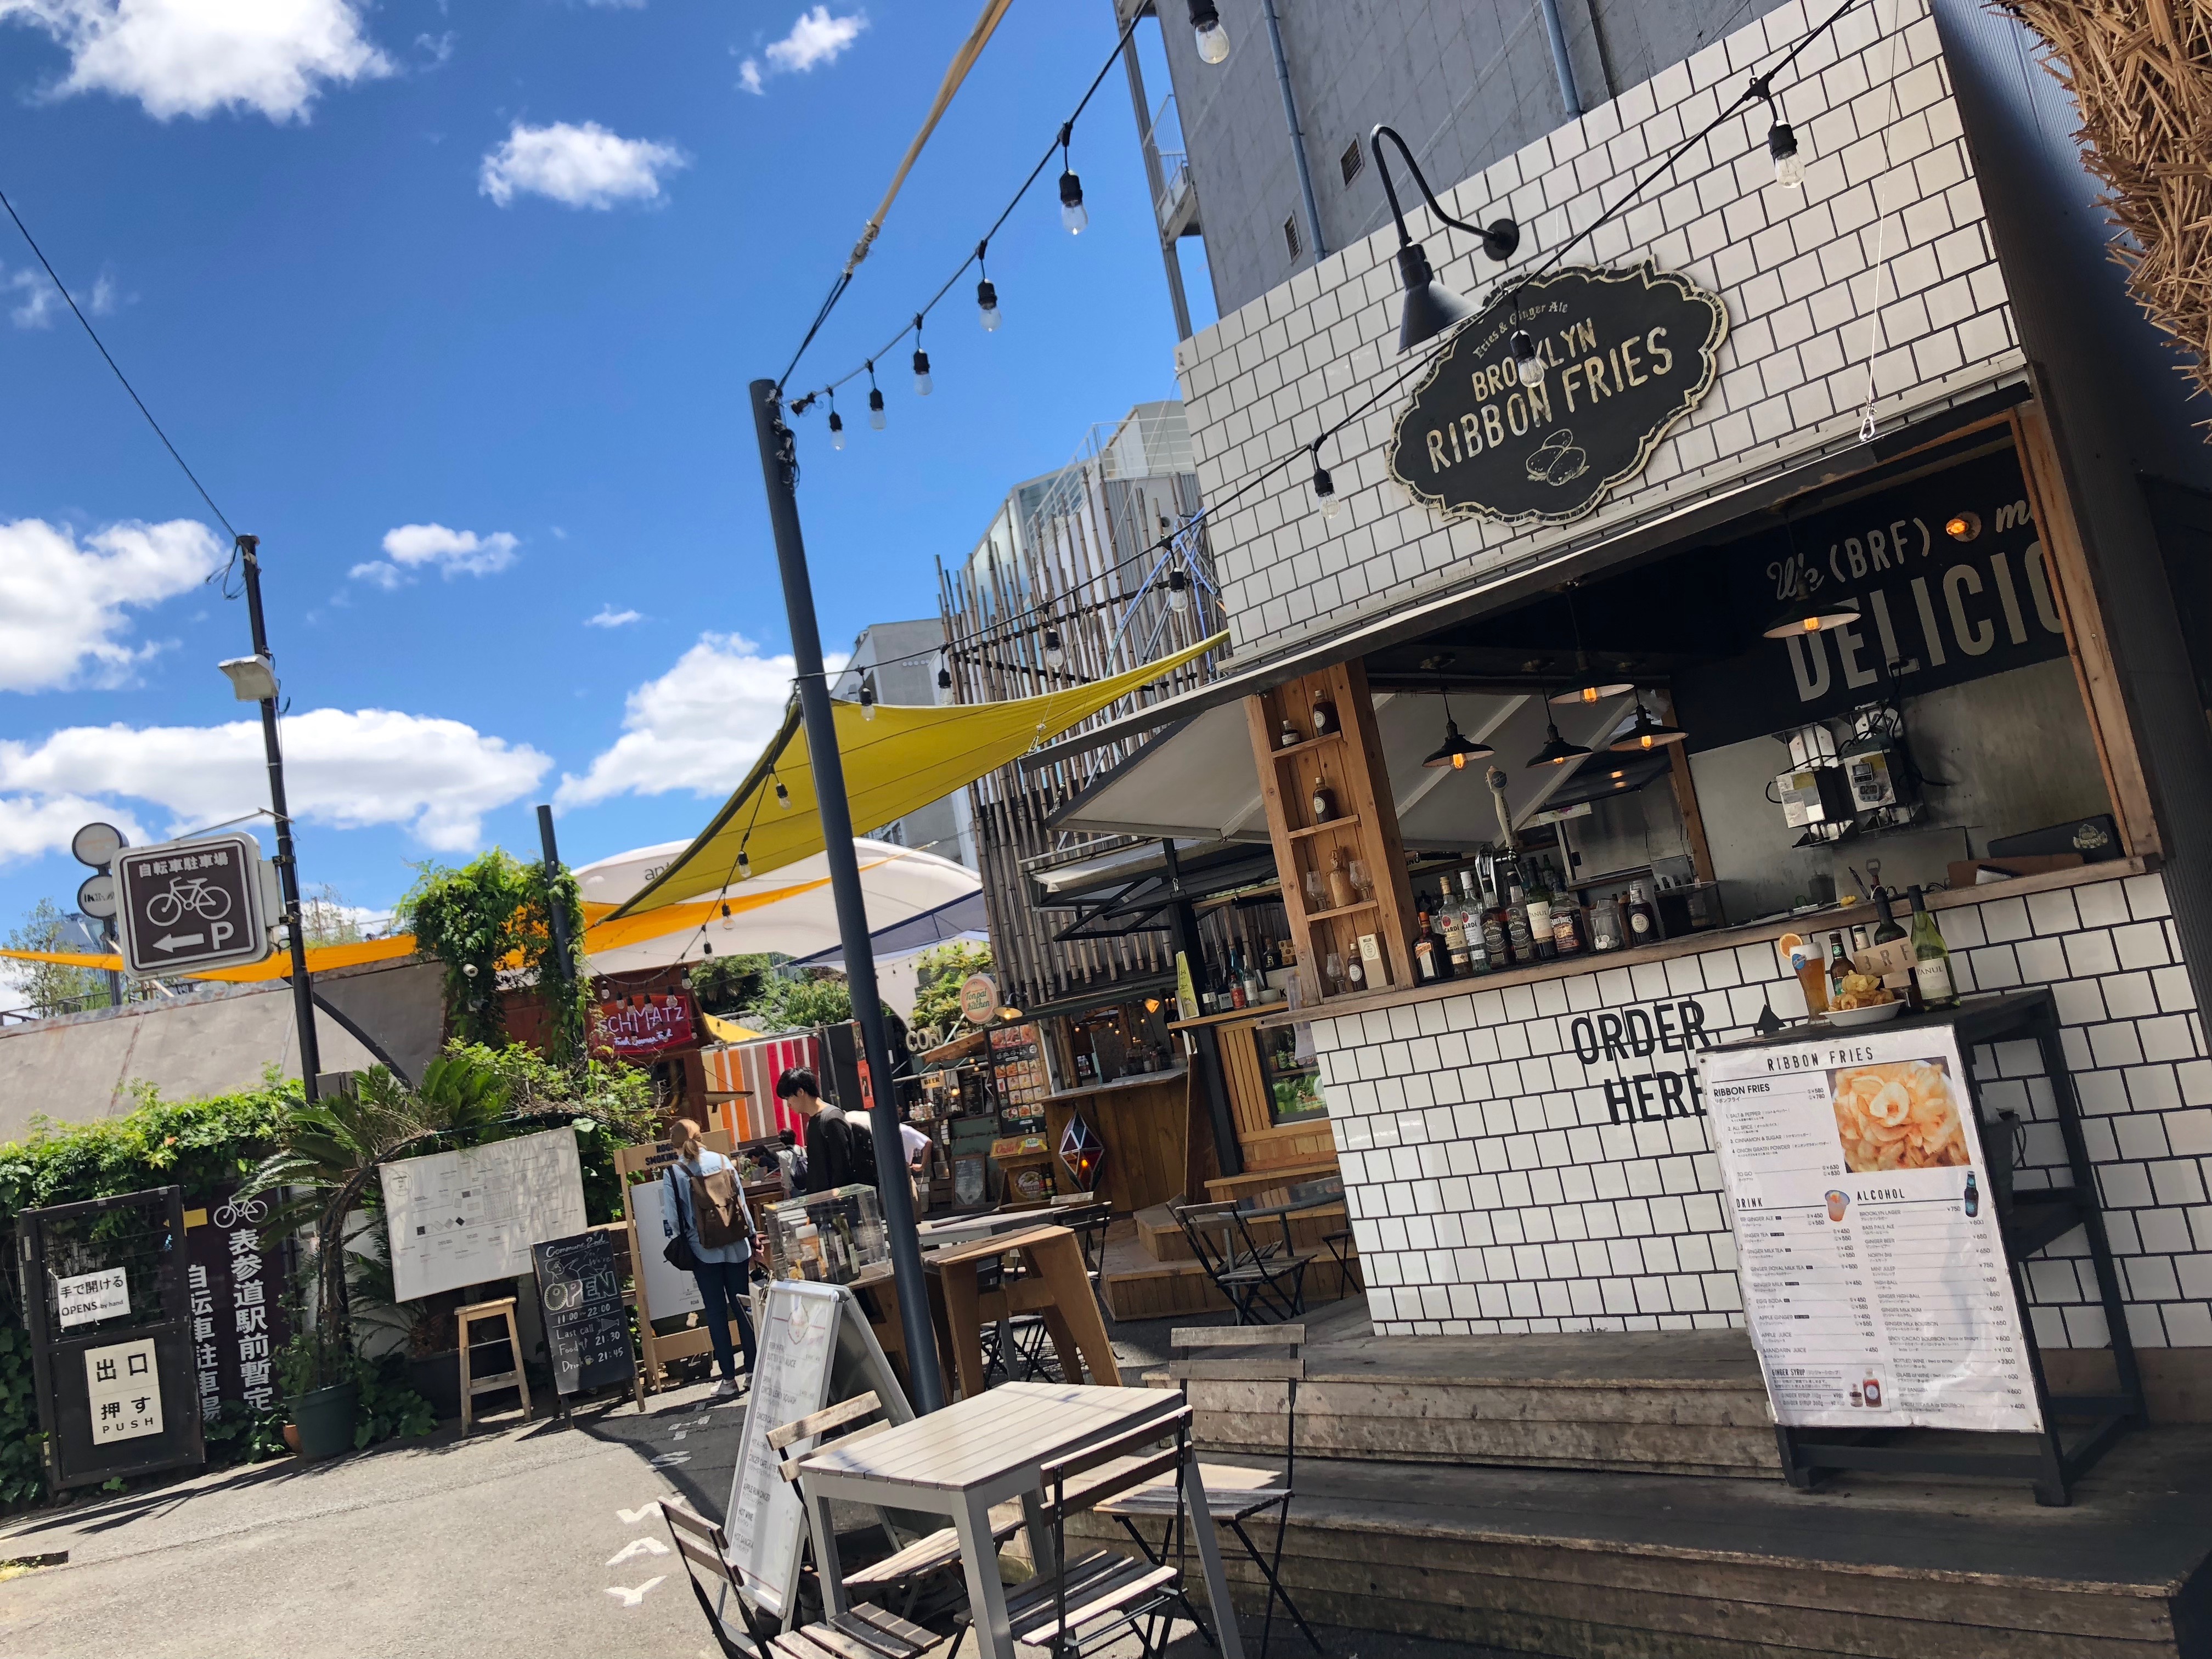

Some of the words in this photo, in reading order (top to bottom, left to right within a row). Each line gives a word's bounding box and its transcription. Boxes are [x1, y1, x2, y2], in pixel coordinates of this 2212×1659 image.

[1472, 330, 1499, 359] Fries
[1499, 322, 1508, 334] &
[1548, 302, 1568, 313] Ale
[1471, 316, 1597, 402] BROKLYN
[1426, 381, 1553, 474] RIBBON
[1561, 326, 1673, 413] FRIES
[1766, 552, 1825, 601] We
[1830, 517, 1930, 583] (BRF)
[1996, 500, 2035, 533] m
[138, 851, 229, 878] 自転車駐車場
[210, 921, 234, 950] P
[1571, 1001, 1711, 1065] ORDER
[1767, 1053, 1819, 1071] RIBBON
[1829, 1046, 1874, 1064] FRIES
[924, 1077, 940, 1085] BEER
[1713, 1085, 1746, 1097] RIBBON
[1747, 1083, 1770, 1093] FRIES
[1736, 1197, 1764, 1208] DRINK
[1857, 1188, 1905, 1201] ALCOHOL
[60, 1276, 123, 1298] 手で開ける
[544, 1271, 618, 1311] OPEN
[61, 1301, 98, 1316] OPENS
[228, 1228, 274, 1412] 表参道駅前暫定
[588, 1304, 611, 1317] 22:00
[556, 1329, 577, 1340] Last
[580, 1323, 594, 1335] call
[559, 1340, 579, 1356] Food
[595, 1331, 620, 1346] 21:30
[598, 1347, 624, 1363] 21:45
[97, 1353, 148, 1383] 出口
[100, 1396, 151, 1420] 押す
[102, 1417, 154, 1434] PUSH
